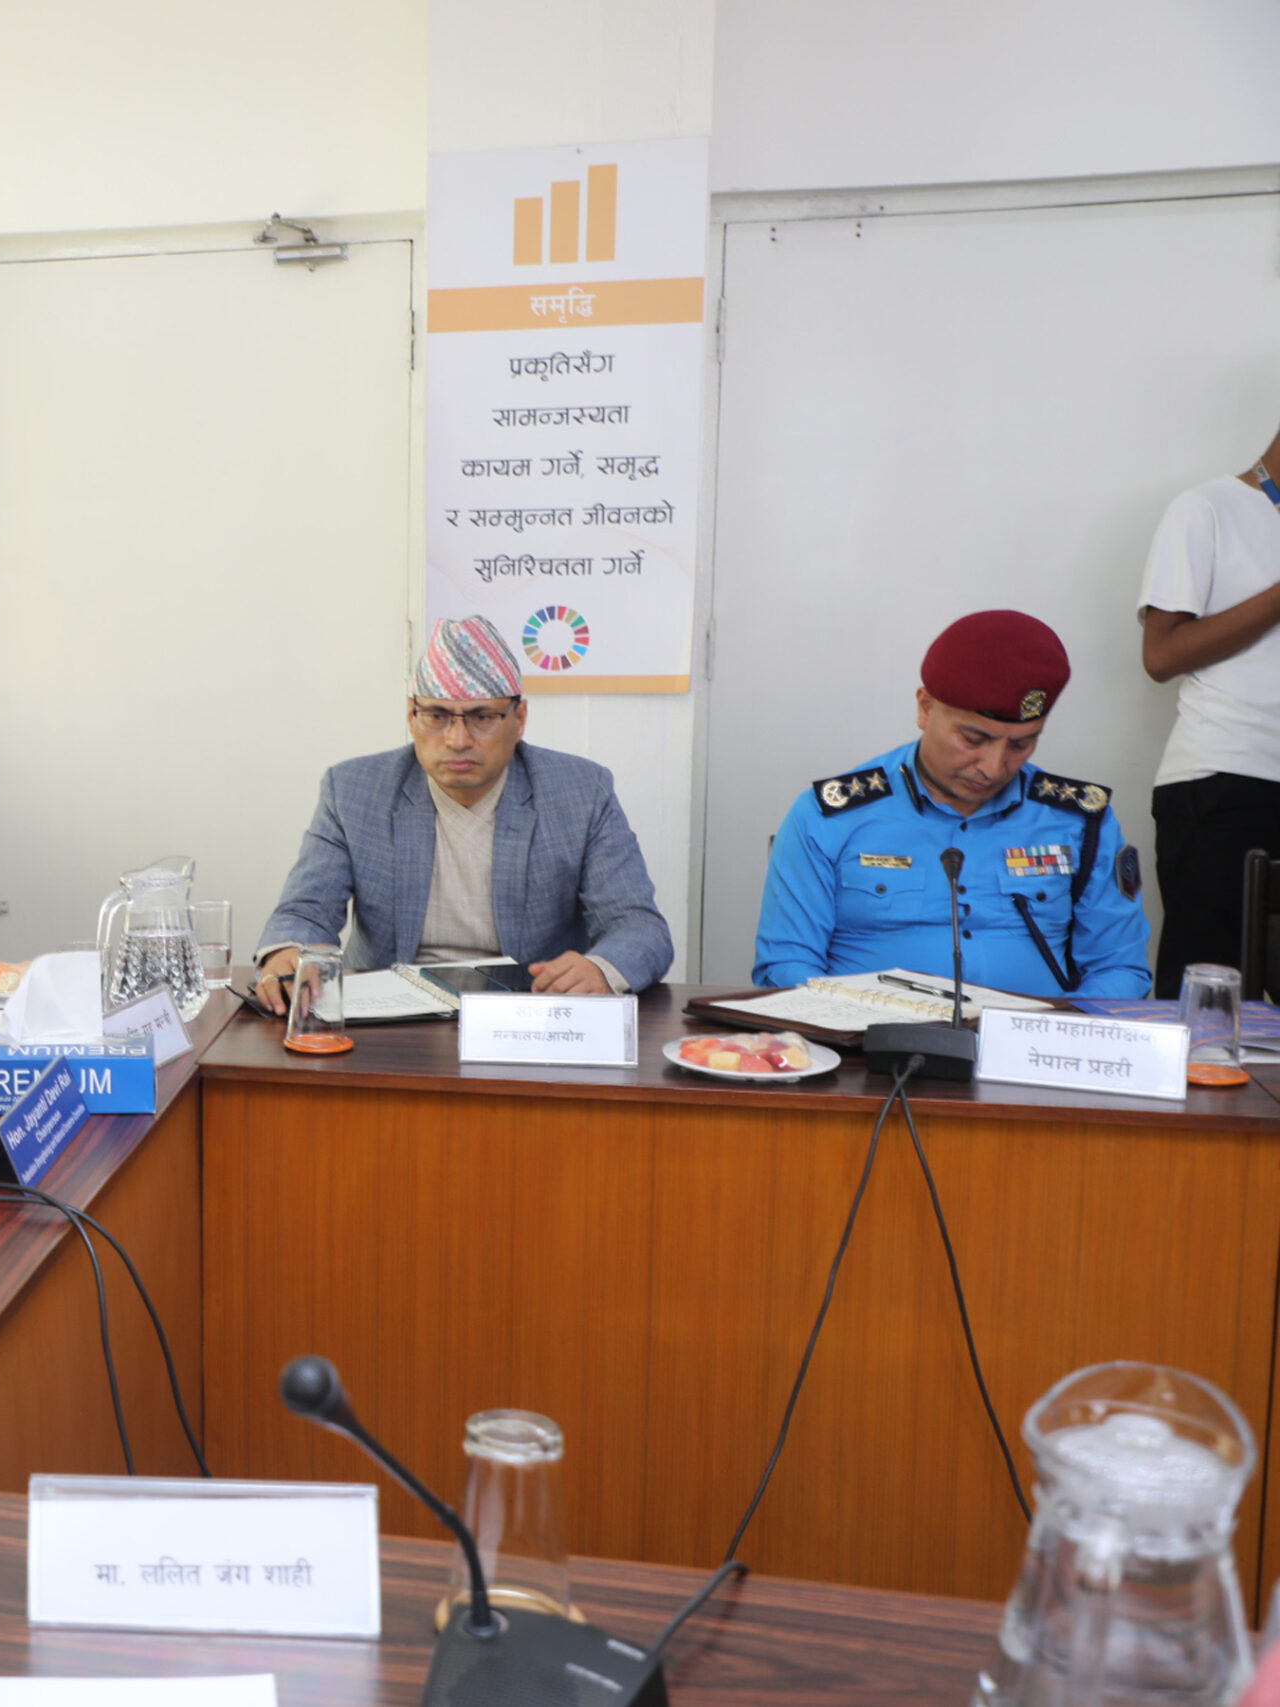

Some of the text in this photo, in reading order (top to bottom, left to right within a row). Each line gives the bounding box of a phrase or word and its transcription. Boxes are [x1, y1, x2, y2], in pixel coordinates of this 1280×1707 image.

[529, 286, 597, 324] समृद्धि
[509, 349, 615, 382] प्रकृतिसँग
[492, 404, 631, 427] सामन्जस्यता
[461, 458, 533, 477] कायम
[596, 455, 661, 481] समृद्ध
[445, 508, 460, 527] र
[582, 499, 675, 526] जीवनको
[473, 549, 645, 583] सुनिश्चितता गर्ने
[1010, 1015, 1051, 1033] प्रहरी
[8, 1044, 147, 1057] PREMIUM
[1028, 1046, 1134, 1078] नेपाल प्रहरी
[94, 1563, 126, 1587] मा.
[138, 1555, 202, 1586] ललित
[262, 1557, 313, 1589] शाही
